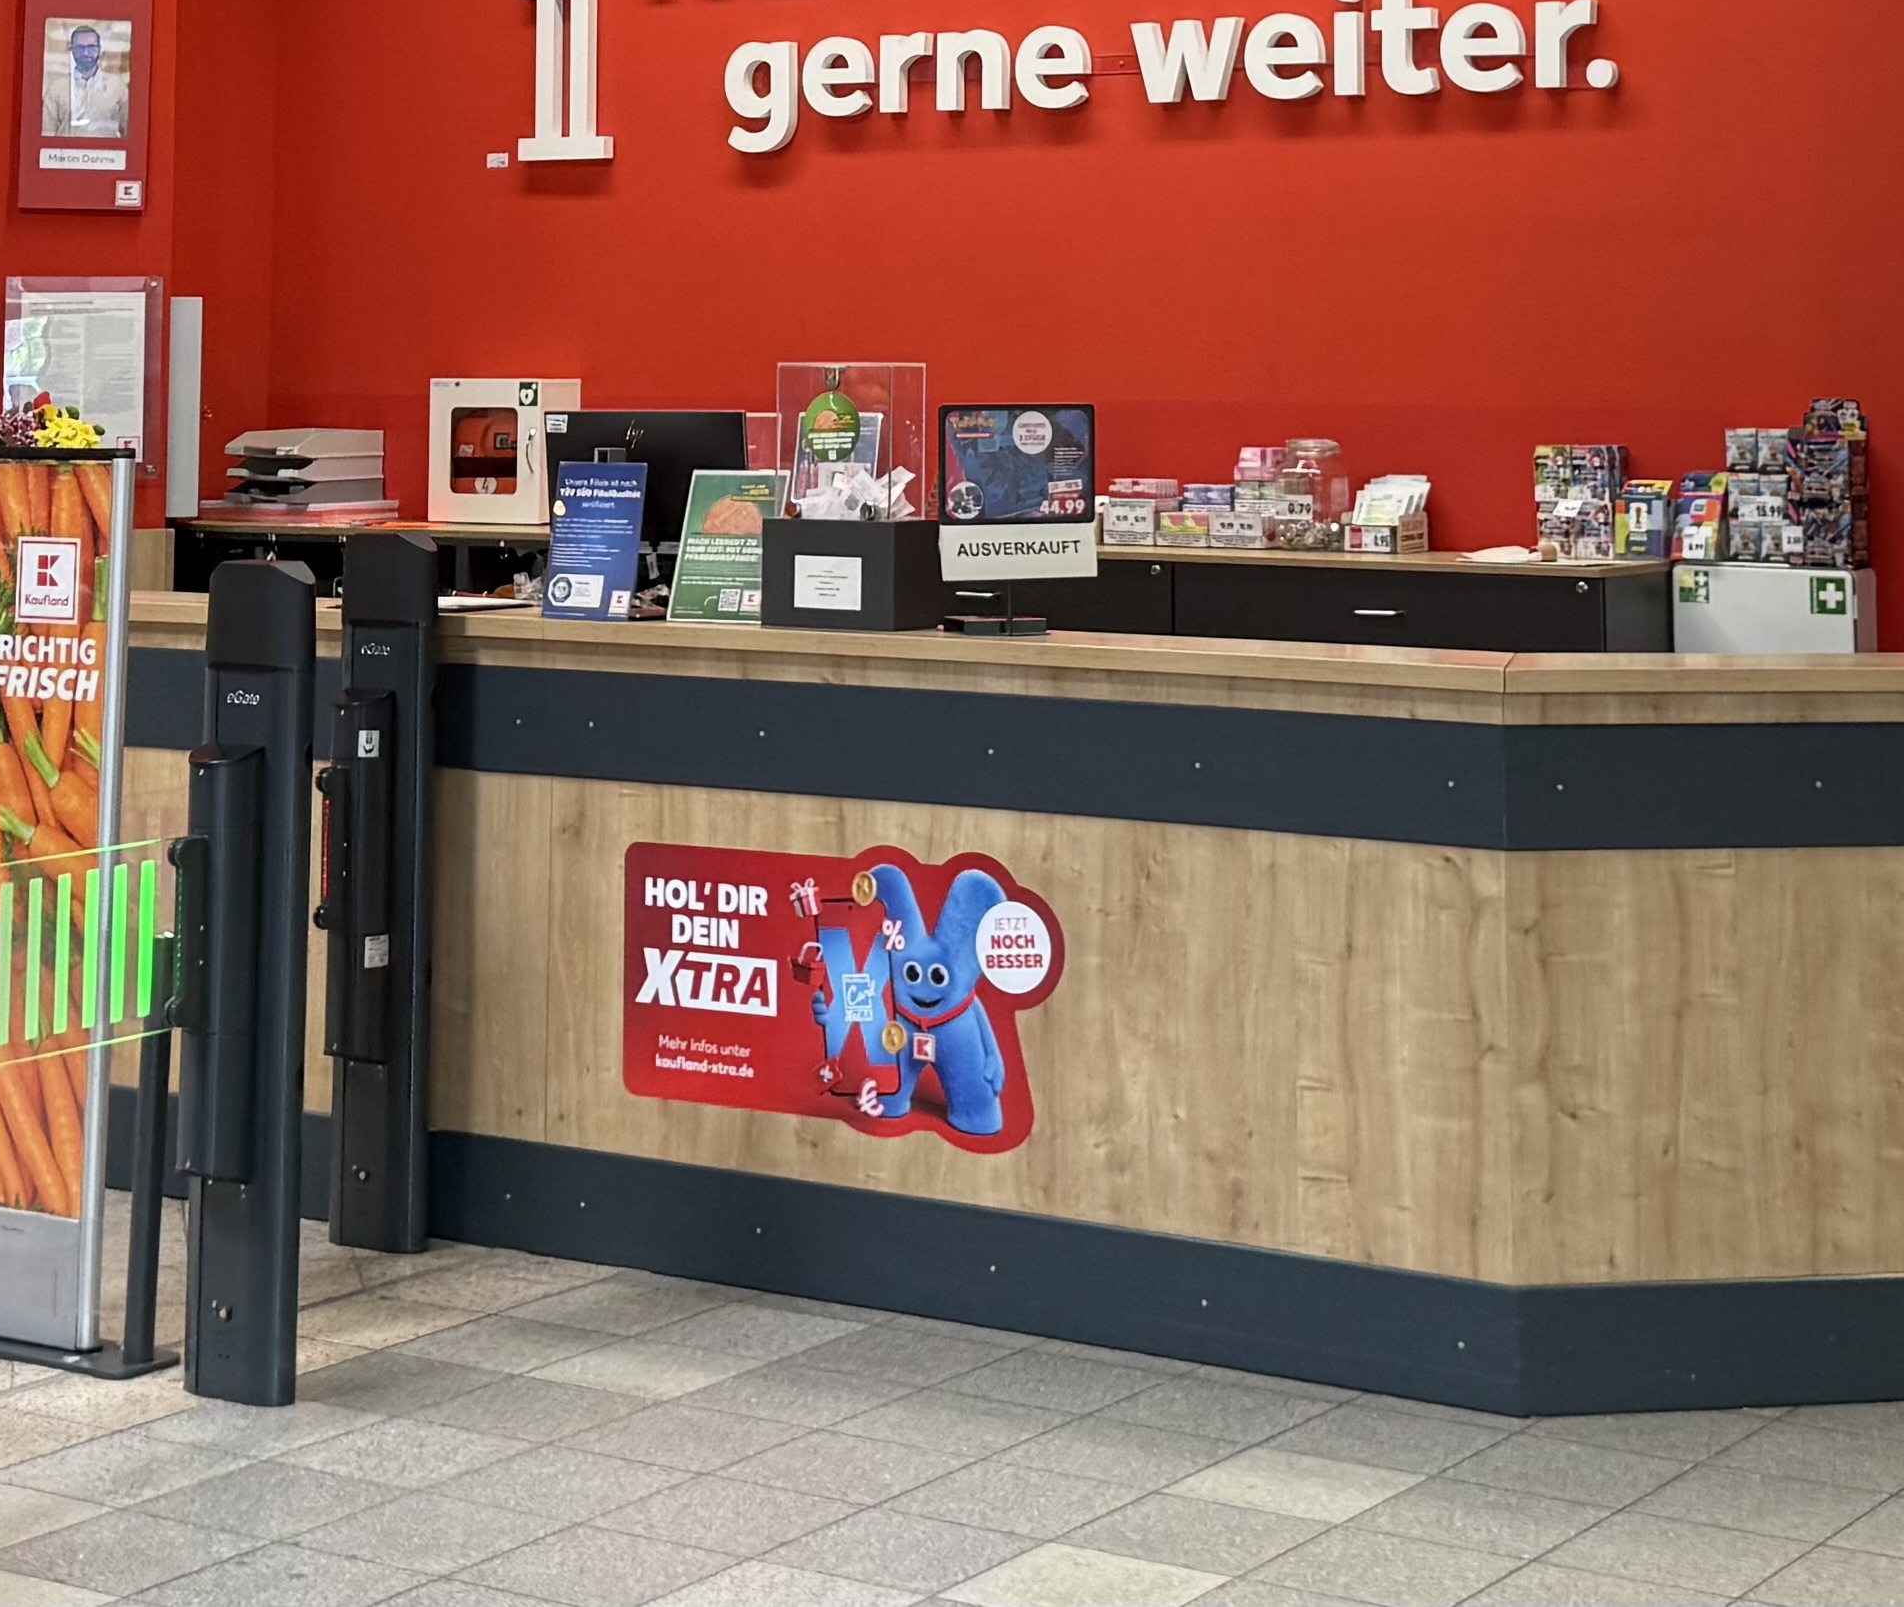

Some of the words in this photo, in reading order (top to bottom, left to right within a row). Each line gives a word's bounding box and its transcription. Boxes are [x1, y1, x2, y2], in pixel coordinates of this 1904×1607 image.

[723, 23, 1092, 155] gerne
[1039, 499, 1085, 515] 44.99
[957, 540, 1081, 558] AUSVERKAUFT
[24, 594, 69, 607] Kaufland
[645, 877, 712, 911] HOL'
[717, 881, 768, 917] DIR
[671, 915, 739, 949] DEIN
[990, 934, 1035, 949] NOCH
[985, 954, 1043, 969] BESSER
[635, 947, 778, 1017] XTRA
[659, 1034, 688, 1050] Mehr
[720, 1045, 751, 1058] unter
[656, 1053, 754, 1079] kaufland-xtra.de
